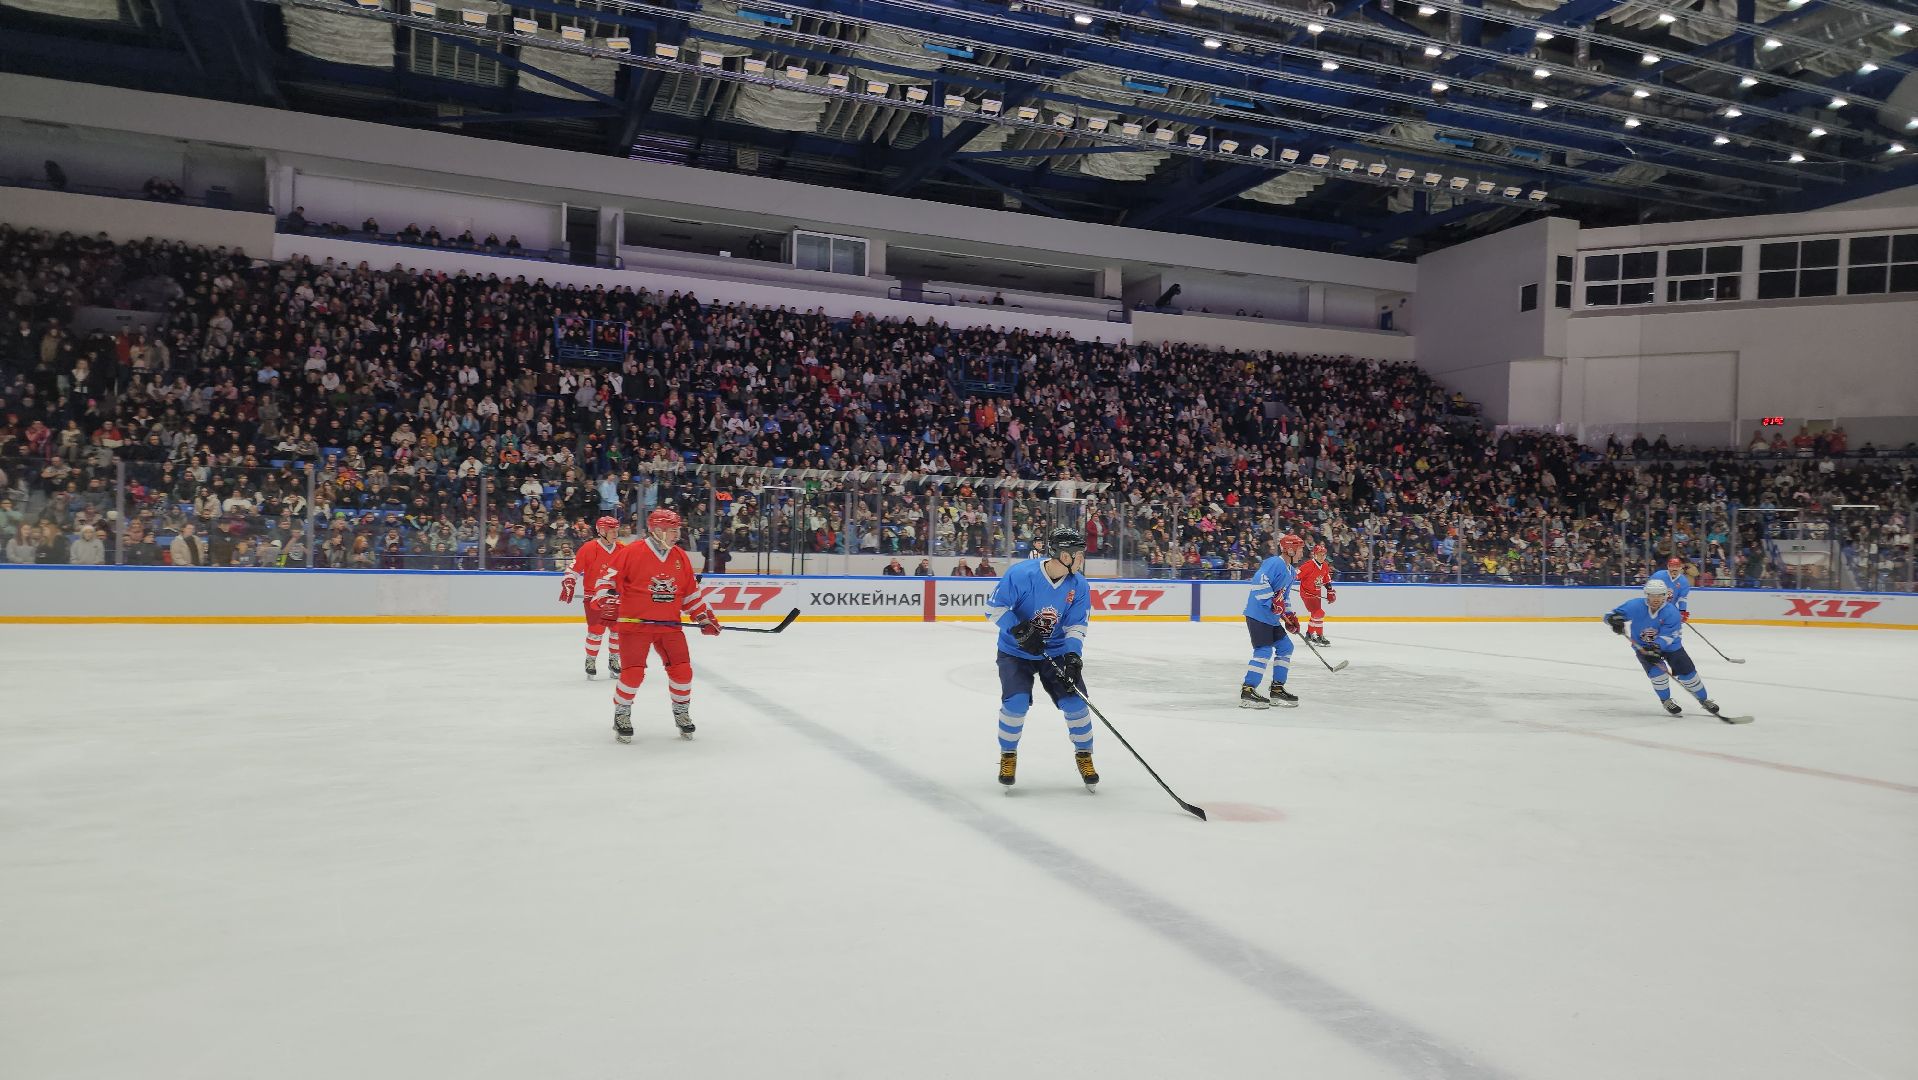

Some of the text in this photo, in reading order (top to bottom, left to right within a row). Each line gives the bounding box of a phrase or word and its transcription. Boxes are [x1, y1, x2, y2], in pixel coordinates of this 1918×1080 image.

[810, 590, 921, 606] ХОККЕЙНАЯ
[938, 593, 991, 607] ЭКИП
[1783, 598, 1881, 618] X17
